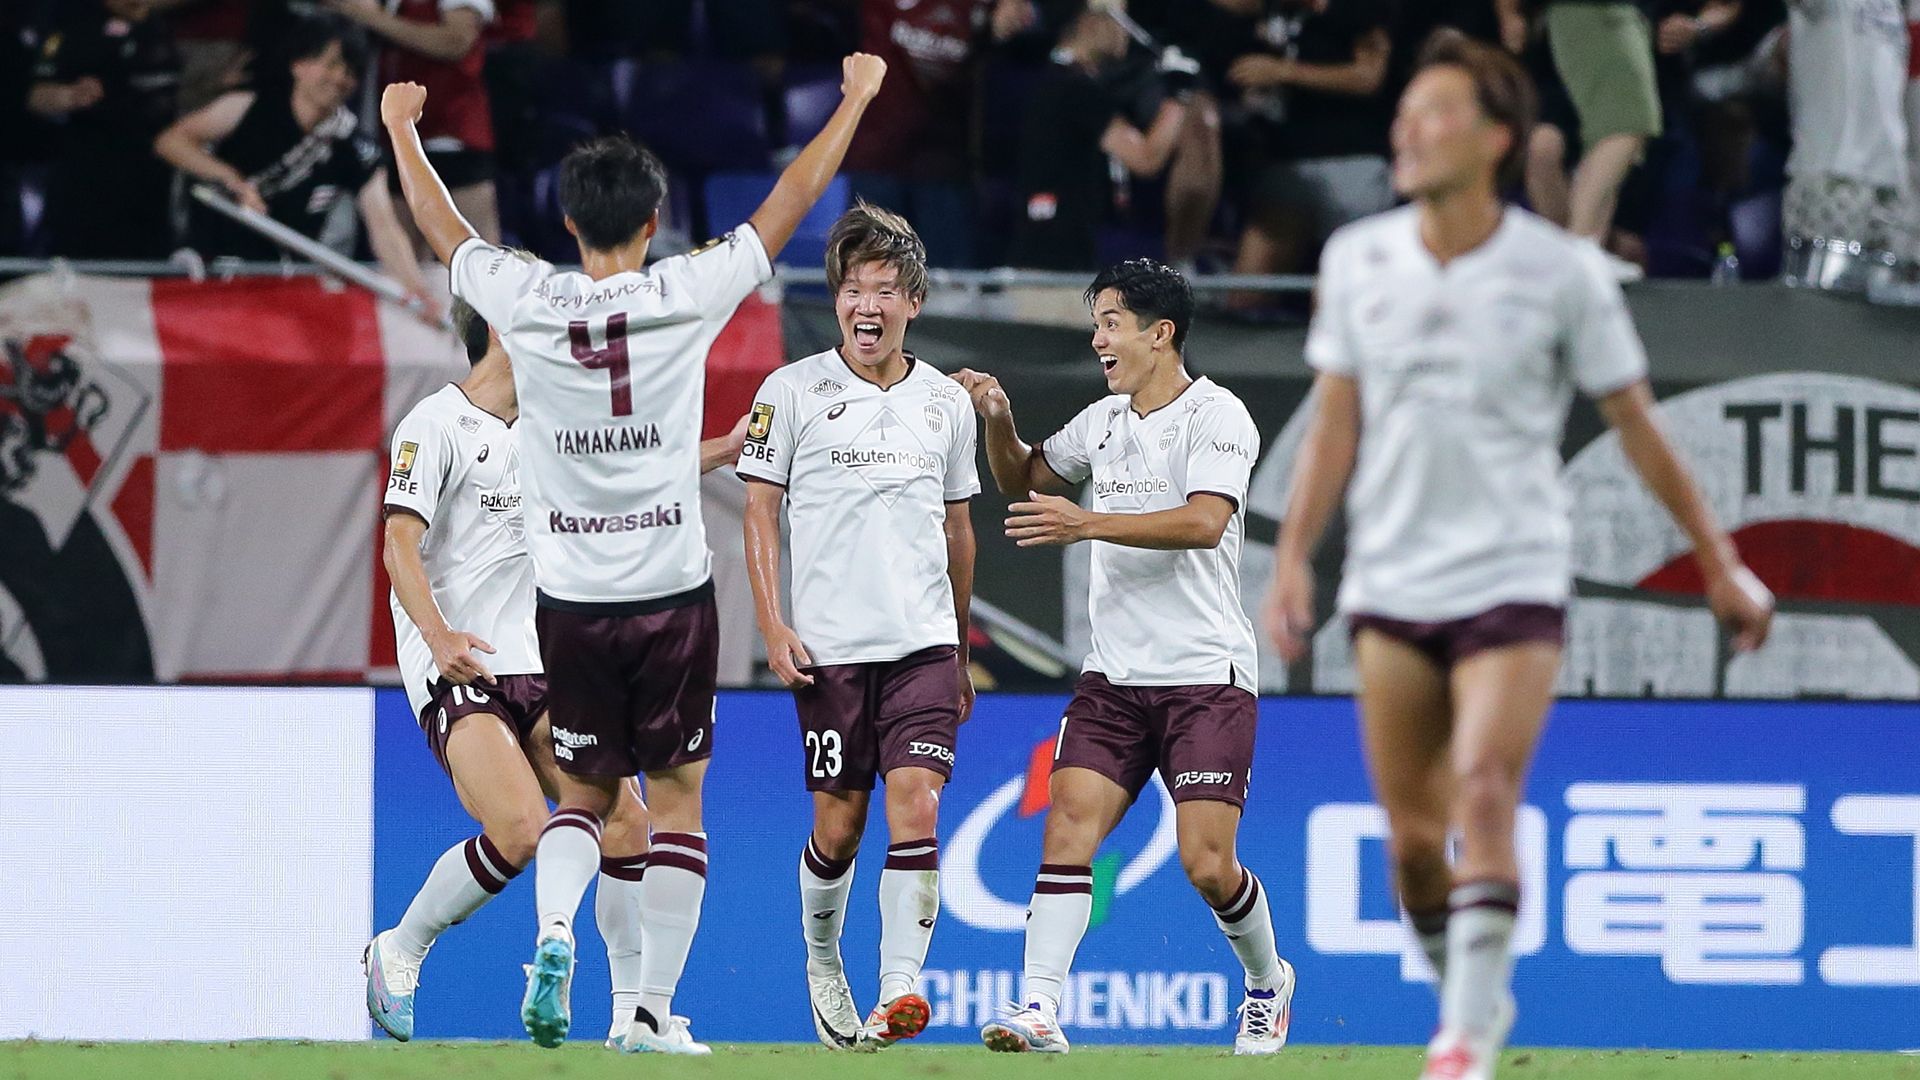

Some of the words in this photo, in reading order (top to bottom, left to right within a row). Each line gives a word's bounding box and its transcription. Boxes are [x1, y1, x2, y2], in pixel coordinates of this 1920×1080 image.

[568, 312, 633, 417] 4
[554, 423, 662, 455] YAMAKAWA
[1723, 403, 1919, 503] THE
[831, 448, 896, 465] Rakuten
[899, 452, 936, 473] Mobile
[549, 502, 682, 534] Kawasaki
[551, 725, 598, 746] Rakuten
[554, 743, 574, 761] toto
[805, 729, 843, 778] 23
[917, 970, 1229, 1030] CHUENKO
